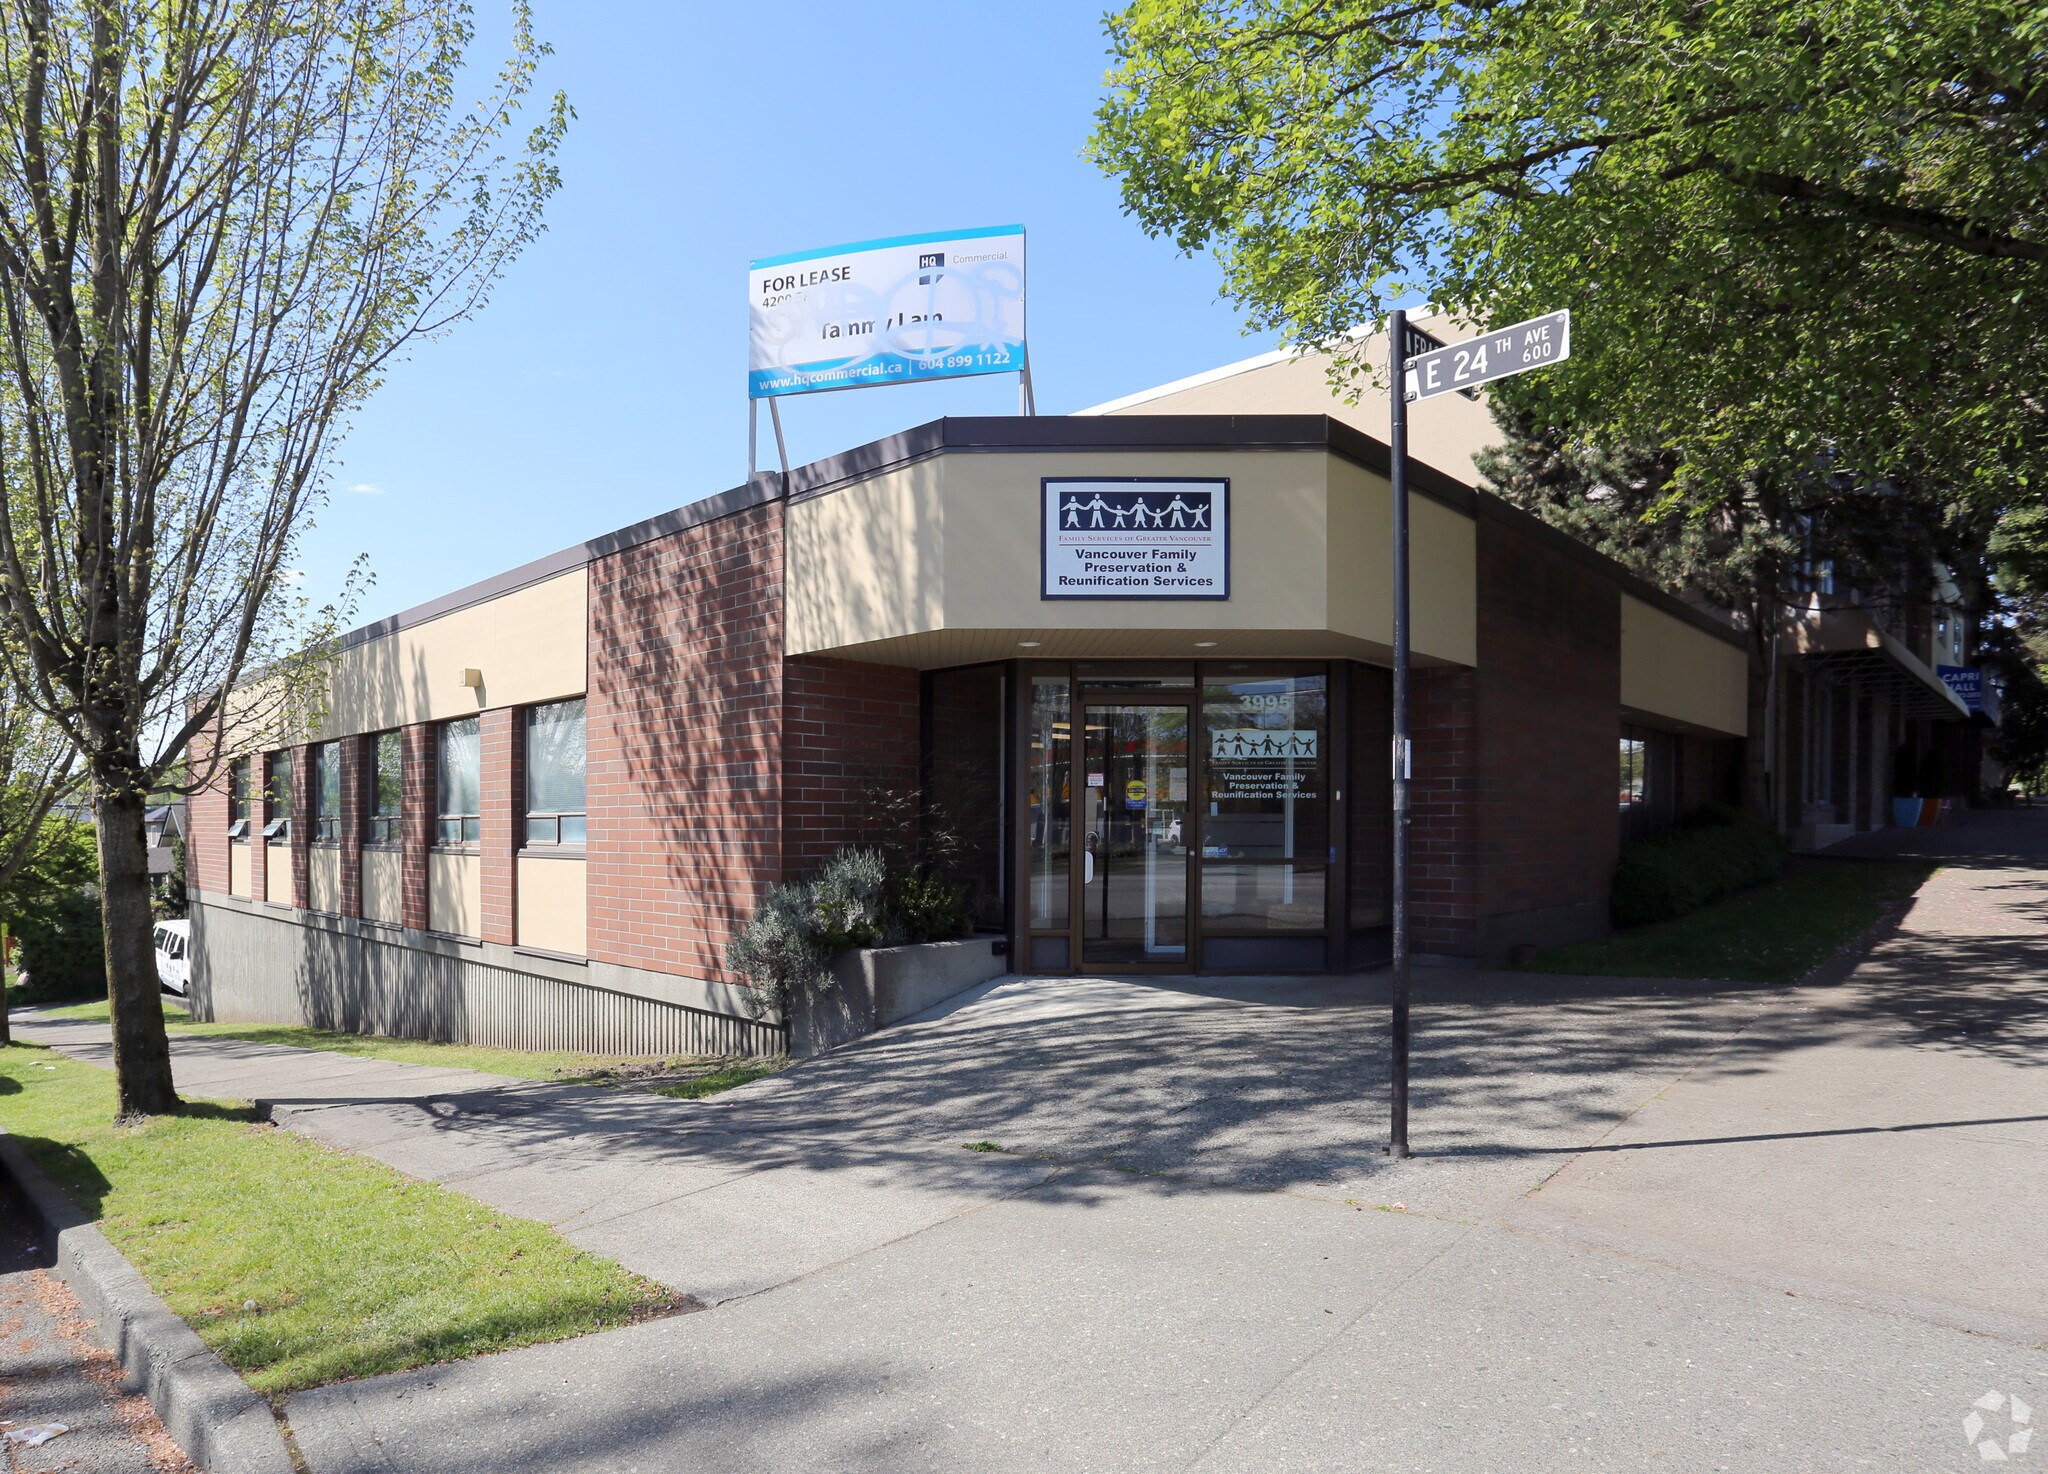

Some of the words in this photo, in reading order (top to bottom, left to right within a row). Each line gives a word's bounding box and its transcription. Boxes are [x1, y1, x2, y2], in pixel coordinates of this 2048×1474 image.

[921, 256, 937, 268] HQ
[952, 251, 1008, 264] Commercial
[763, 275, 795, 293] FOR
[800, 266, 851, 287] LEASE
[1427, 358, 1441, 390] E
[1454, 344, 1488, 382] 24
[1495, 336, 1512, 354] TH
[1524, 325, 1550, 346] AVE
[1522, 342, 1551, 363] 600
[759, 362, 902, 390] www.hqcommercial.ca
[919, 356, 945, 371] 604
[947, 355, 973, 368] 899
[976, 352, 1010, 365] 1122
[1075, 549, 1147, 559] Vancouver
[1152, 549, 1197, 562] Family
[1084, 562, 1172, 573] Preservation
[1176, 562, 1187, 573] &
[1058, 575, 1149, 586] Reunification
[1153, 575, 1213, 586] Services
[1942, 672, 1980, 682] CAPRI
[1275, 773, 1306, 782] Family
[1211, 791, 1273, 799] Reunification
[1276, 791, 1317, 799] Services
